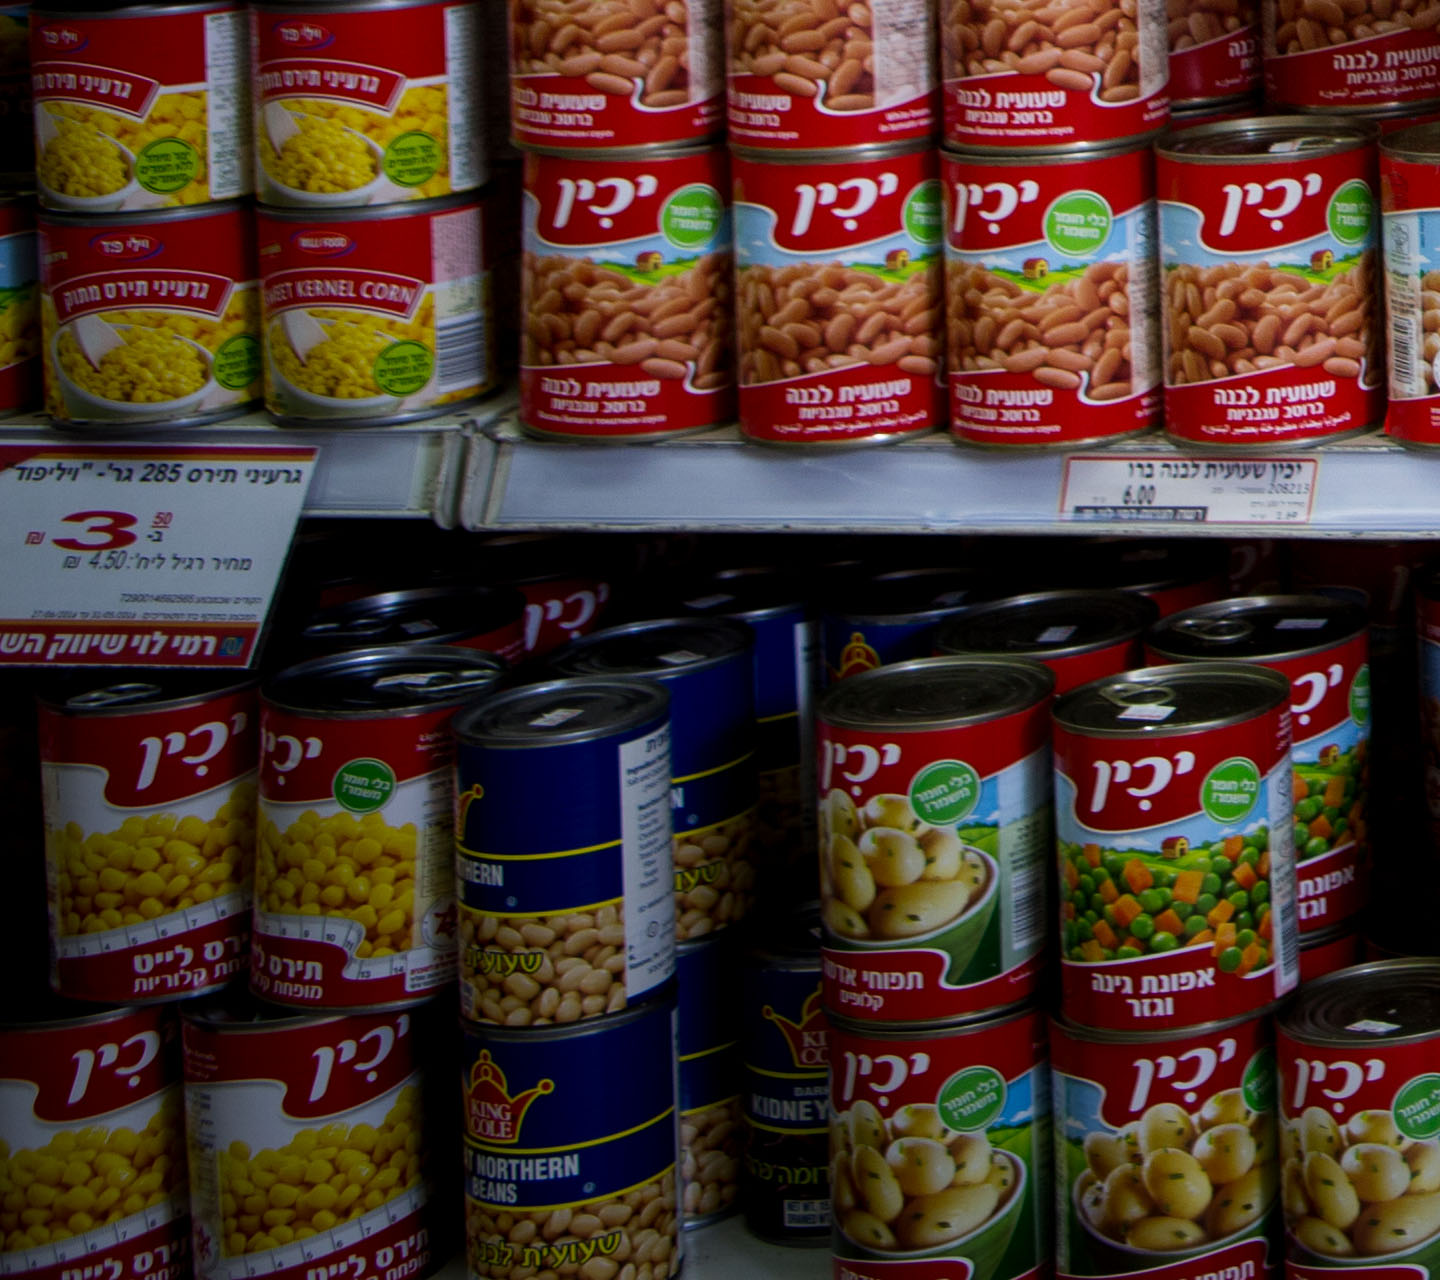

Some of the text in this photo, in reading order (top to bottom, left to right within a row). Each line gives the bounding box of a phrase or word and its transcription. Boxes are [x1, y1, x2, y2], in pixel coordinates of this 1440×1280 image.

[1214, 380, 1336, 407] שעועית לבנה
[139, 463, 303, 484] גרעיני תירס 285
[51, 509, 139, 551] 3
[470, 1099, 513, 1121] KING
[470, 1115, 514, 1140] COLE
[477, 1152, 580, 1179] NORTHERN
[471, 1183, 518, 1204] BEANS
